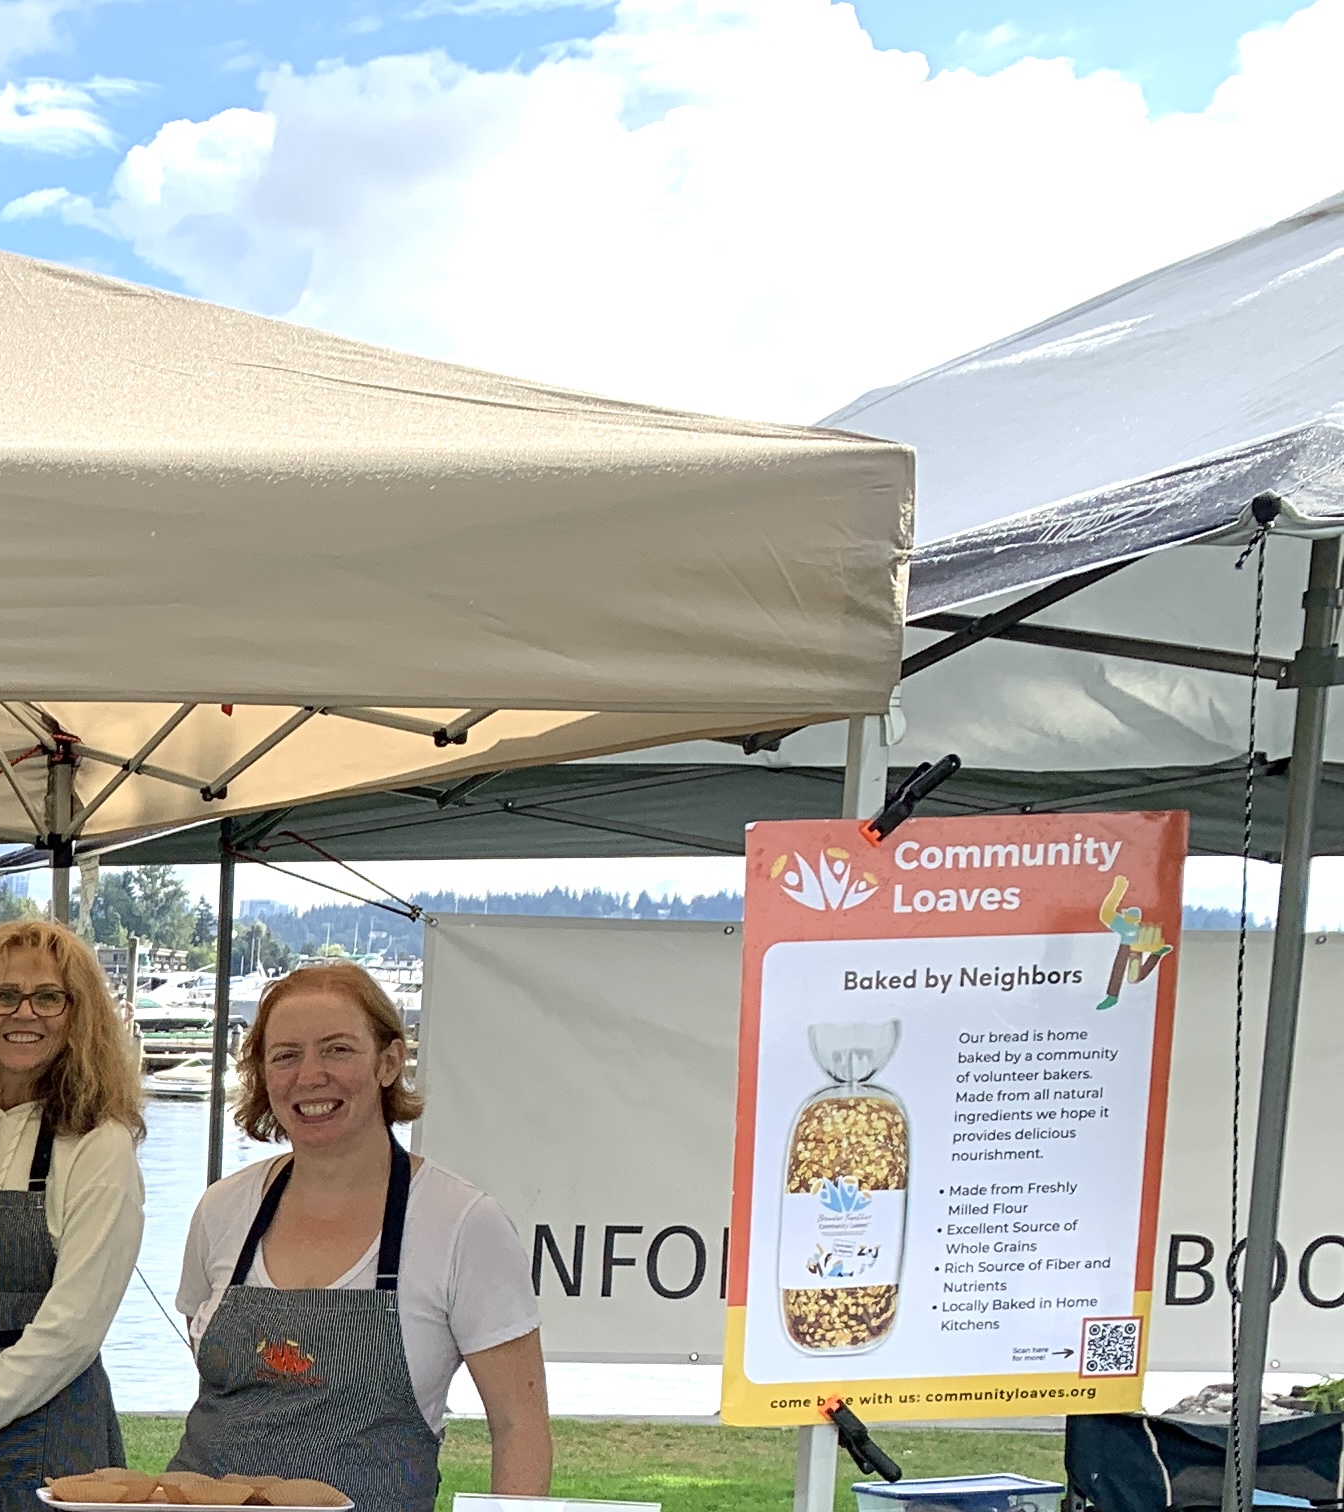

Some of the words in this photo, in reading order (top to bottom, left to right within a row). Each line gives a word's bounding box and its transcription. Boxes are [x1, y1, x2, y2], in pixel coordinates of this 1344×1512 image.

[894, 833, 1122, 872] Community
[893, 884, 1020, 913] Loaves
[844, 969, 916, 991] Baked
[925, 968, 952, 993] by
[960, 964, 1082, 991] Neighbors
[959, 1033, 985, 1044] Our
[989, 1031, 1028, 1043] bread
[1033, 1030, 1043, 1041] is
[1047, 1030, 1088, 1041] home
[958, 1051, 1000, 1063] baked
[1005, 1051, 1021, 1064] by
[1025, 1053, 1032, 1061] a
[1037, 1047, 1118, 1061] community
[956, 1072, 970, 1083] of
[974, 1071, 1039, 1082] volunteer
[1044, 1069, 1092, 1080] bakers.
[956, 1091, 993, 1102] Made
[997, 1090, 1029, 1101] from
[1034, 1089, 1049, 1100] all
[1054, 1087, 1103, 1100] natural
[954, 1110, 1032, 1124] ingredients
[1036, 1111, 1056, 1119] we
[1061, 1108, 1096, 1120] hope
[1100, 1107, 1109, 1117] it
[953, 1129, 1011, 1144] provides
[1015, 1128, 1076, 1140] delicious
[952, 1149, 1043, 1161] nourishment.
[949, 1184, 987, 1196] Made
[991, 1183, 1023, 1195] from
[1028, 1182, 1077, 1195] Freshly
[948, 1204, 989, 1216] Milled
[993, 1203, 1028, 1214] Flour
[947, 1223, 1008, 1235] Excellent
[1012, 1221, 1060, 1232] Source
[1064, 1220, 1078, 1231] of
[946, 1243, 989, 1254] Whole
[994, 1241, 1037, 1252] Grains
[945, 1262, 974, 1273] Rich
[978, 1261, 1024, 1272] Source
[1029, 1260, 1042, 1271] of
[1046, 1259, 1080, 1270] Fiber
[1085, 1258, 1111, 1269] and
[943, 1281, 1007, 1292] Nutrients
[942, 1300, 988, 1313] Locally
[993, 1299, 1035, 1310] Baked
[1040, 1298, 1051, 1308] in
[1056, 1297, 1097, 1308] Home
[941, 1319, 1000, 1331] Kitchens
[770, 1397, 811, 1409] come
[817, 1395, 853, 1407] be
[860, 1393, 892, 1406] with
[899, 1392, 920, 1404] us:
[926, 1387, 1096, 1403] communityloaves.org
